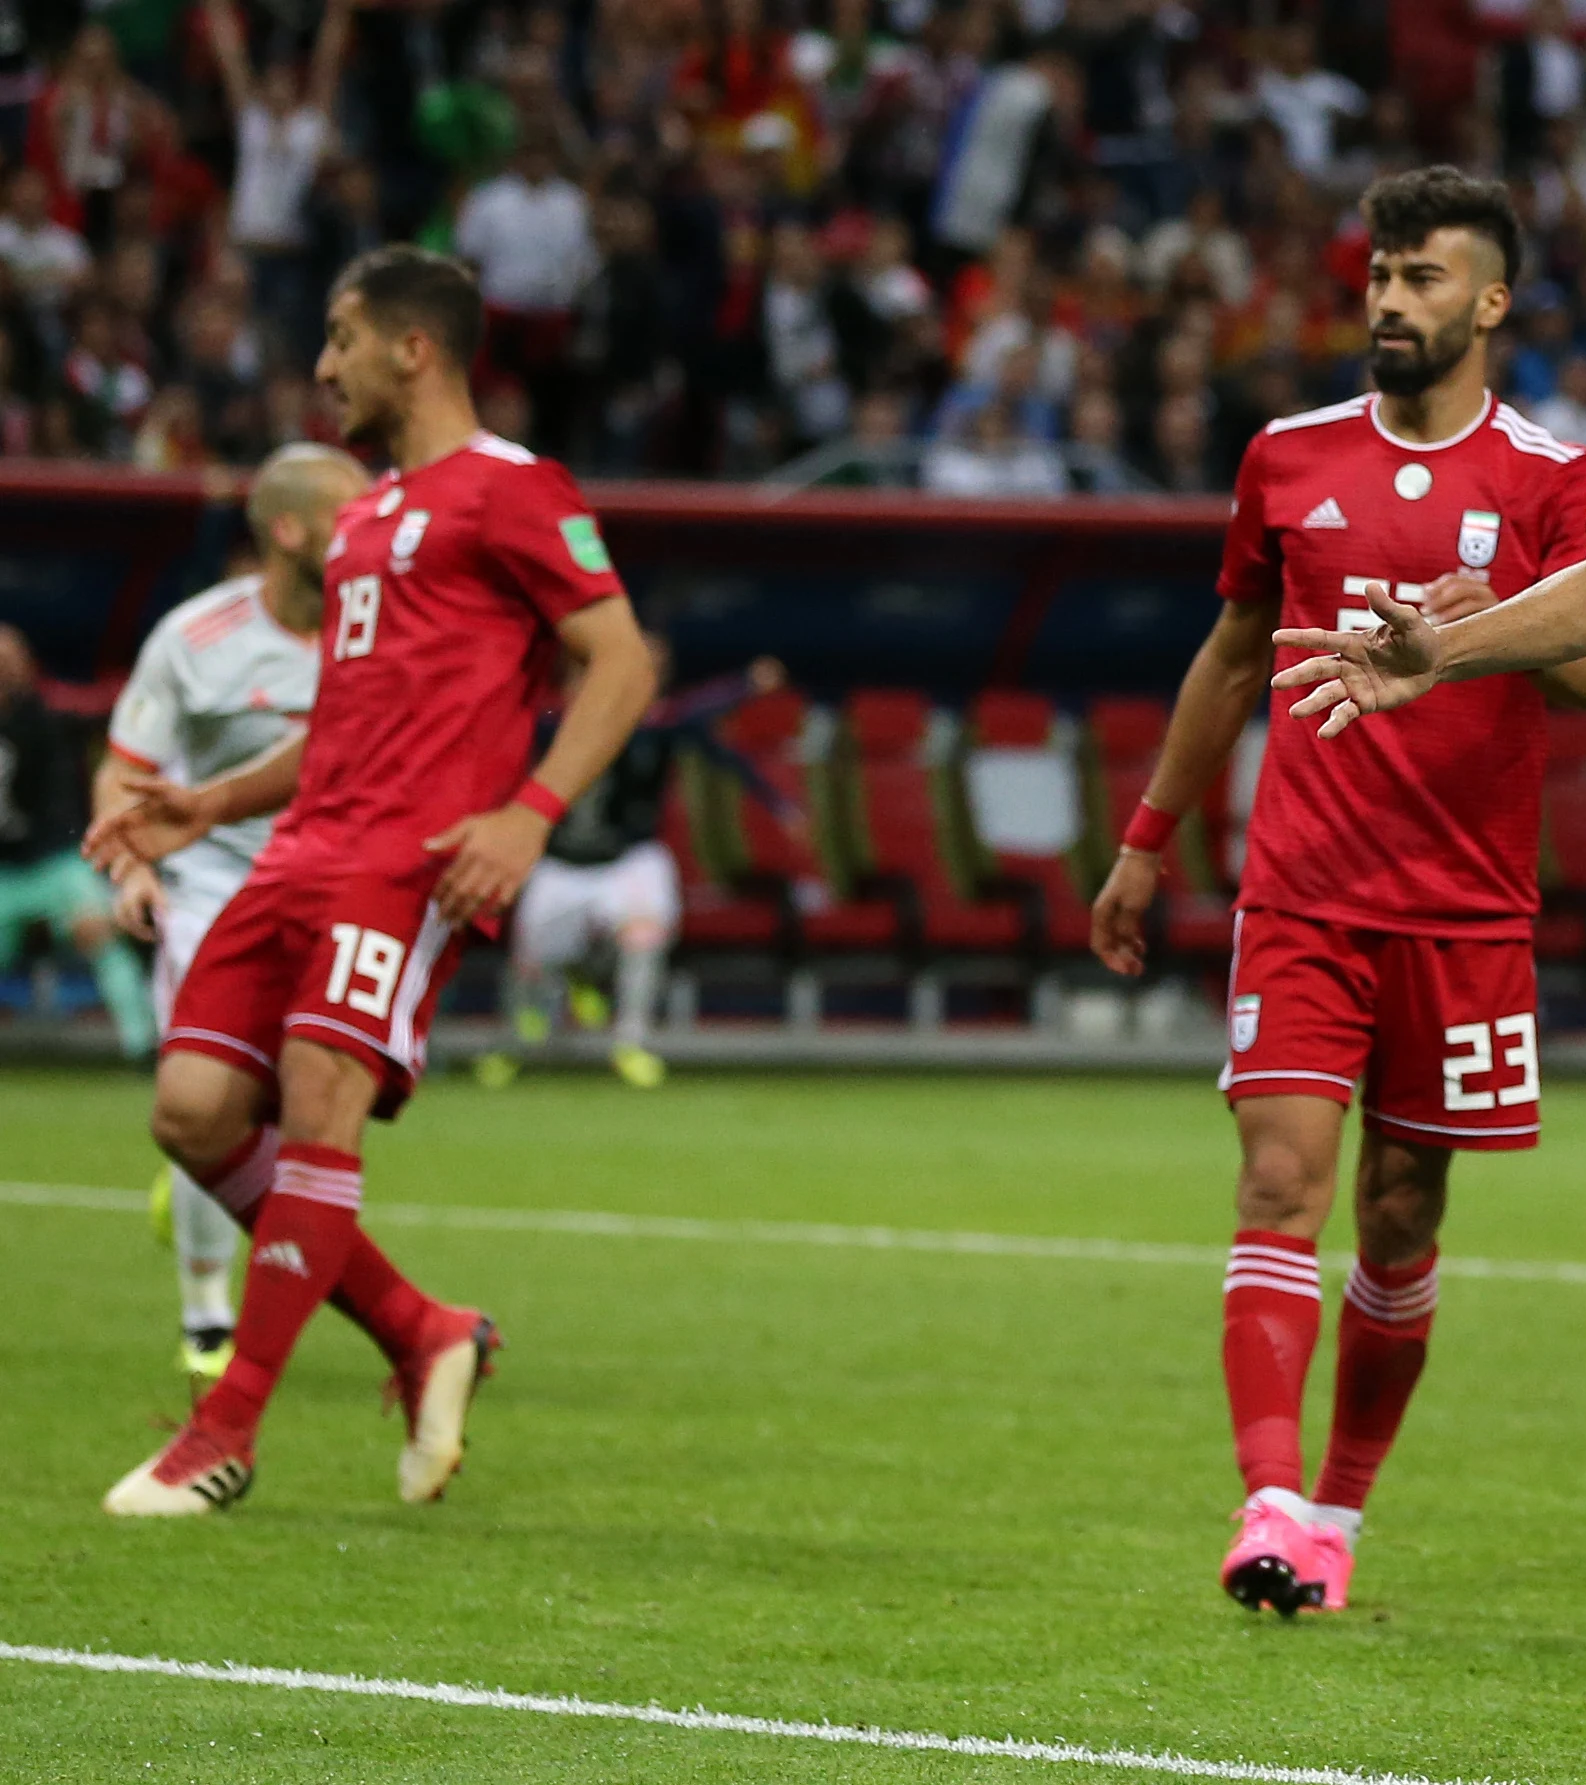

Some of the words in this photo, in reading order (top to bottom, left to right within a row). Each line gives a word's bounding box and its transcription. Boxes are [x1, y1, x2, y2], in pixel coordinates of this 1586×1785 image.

[333, 573, 382, 662] 19
[325, 922, 406, 1020] 19
[1442, 1012, 1540, 1111] 23
